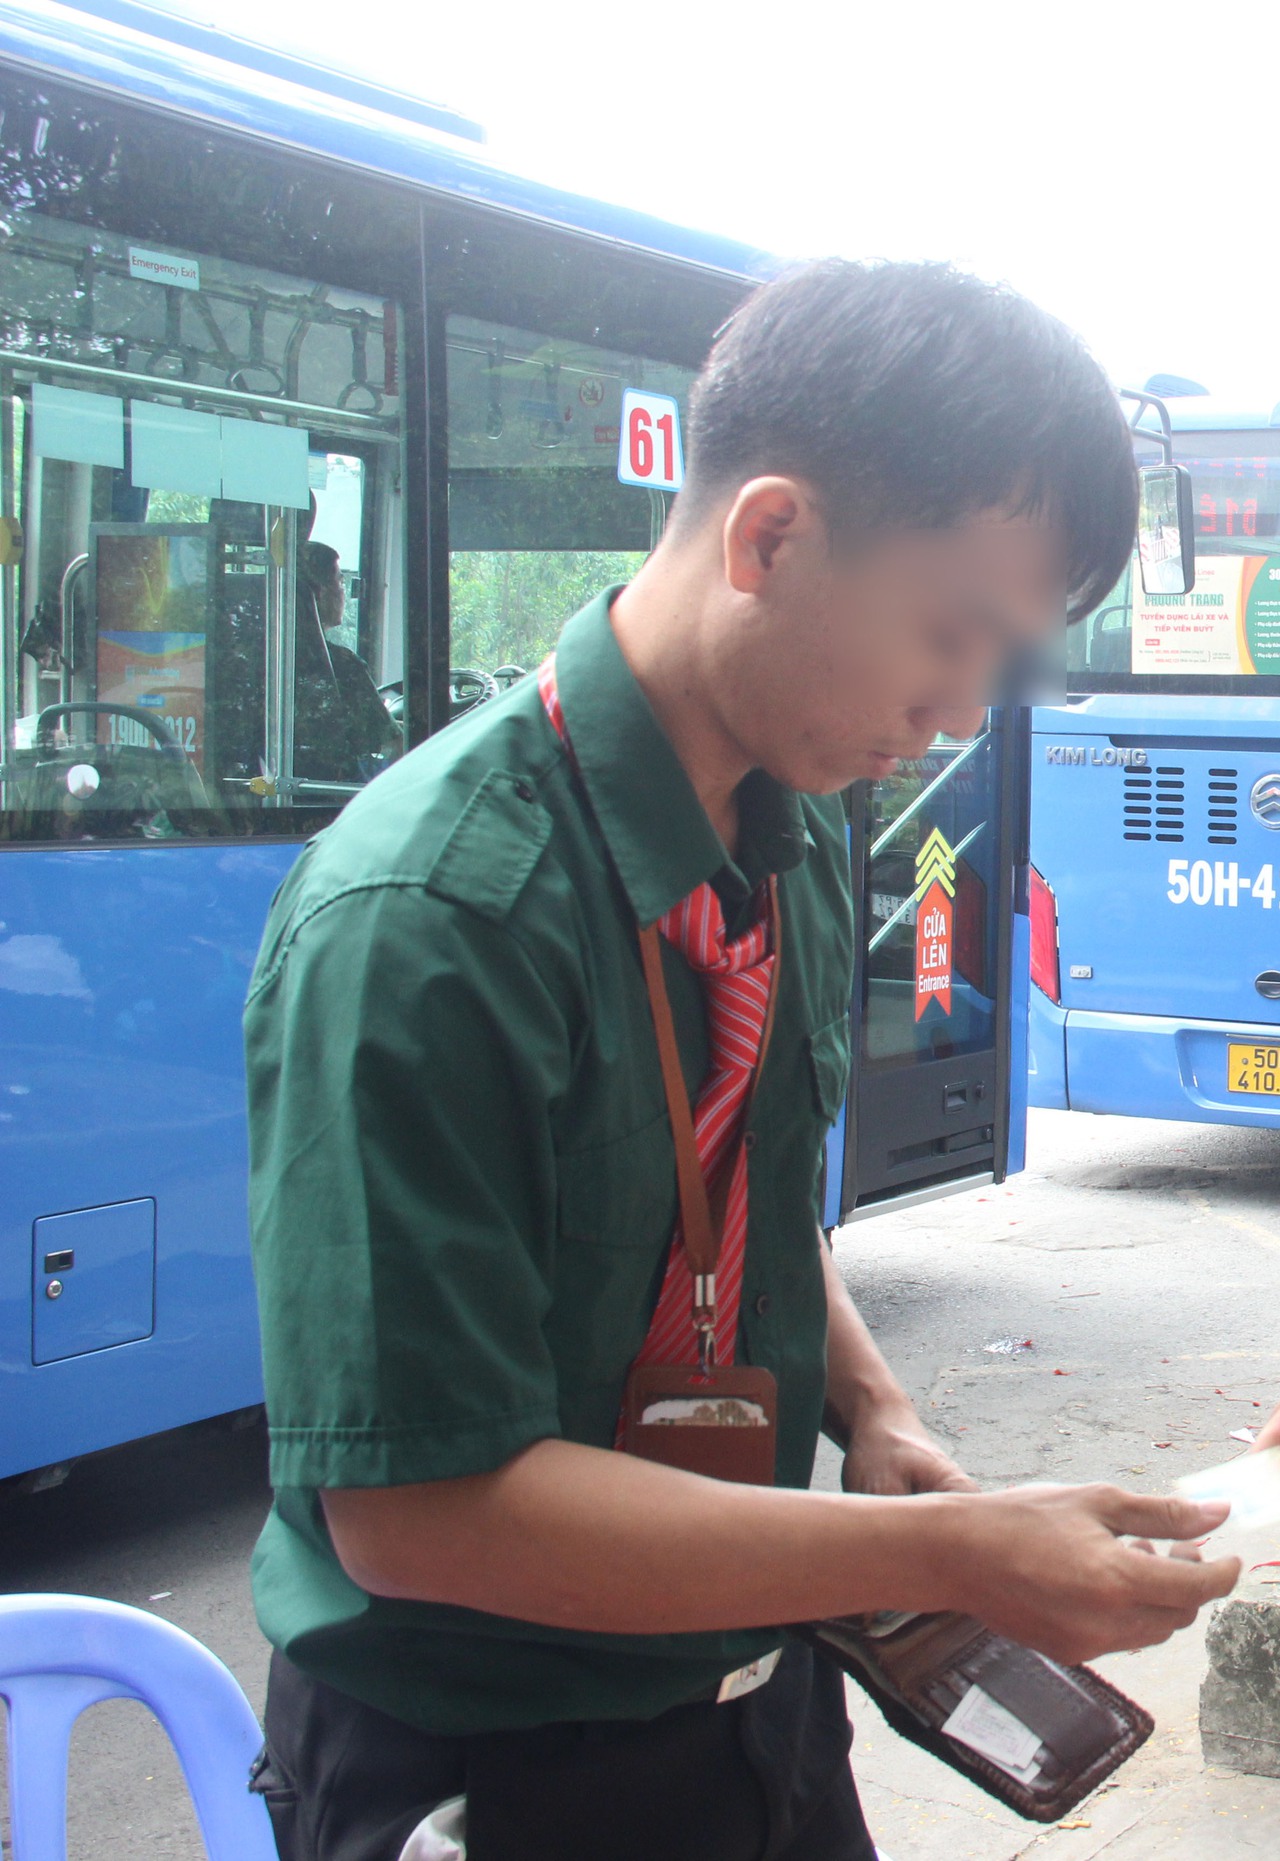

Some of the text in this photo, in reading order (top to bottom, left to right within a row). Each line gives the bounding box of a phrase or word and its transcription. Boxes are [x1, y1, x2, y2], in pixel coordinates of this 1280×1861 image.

[131, 255, 197, 279] Emergency Exit
[628, 406, 674, 482] 61
[1190, 594, 1224, 606] TRANG
[1191, 612, 1204, 620] LÁI
[1218, 612, 1230, 620] VÀ
[1154, 624, 1172, 632] TIẾP
[1173, 624, 1192, 632] VIÊN
[1046, 746, 1147, 766] KIM LONG
[924, 907, 946, 939] CỬA
[922, 939, 947, 969] LÊN
[918, 974, 950, 994] Entrance
